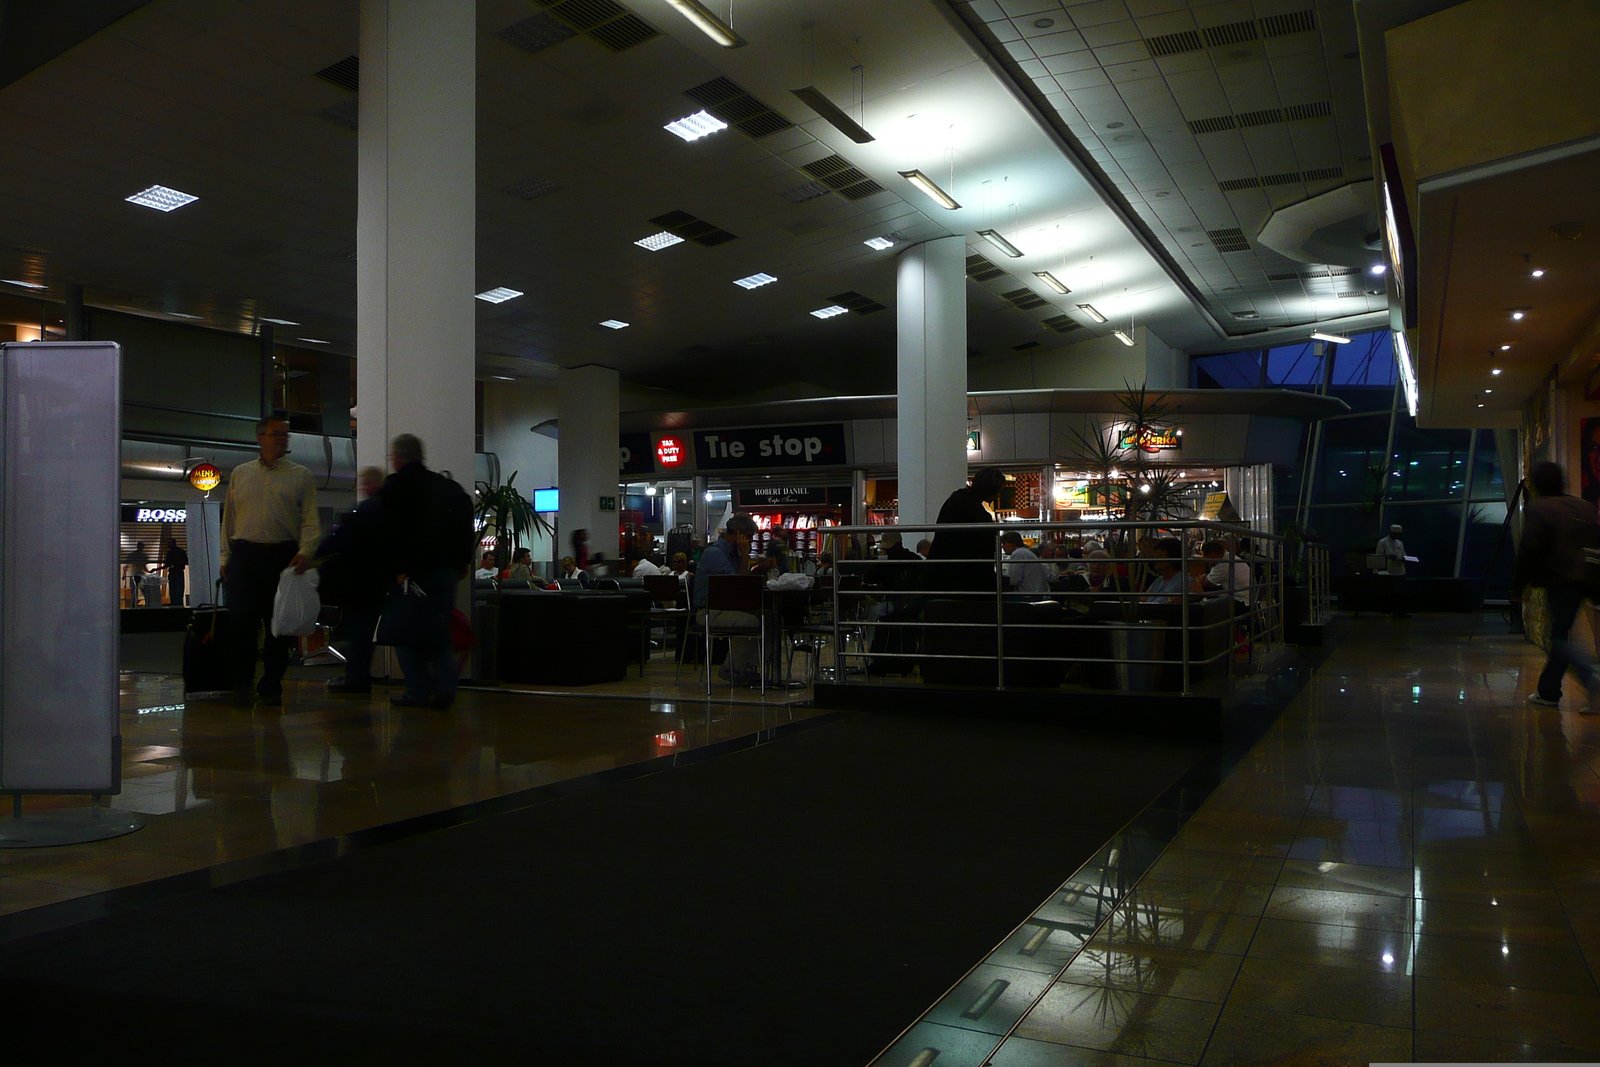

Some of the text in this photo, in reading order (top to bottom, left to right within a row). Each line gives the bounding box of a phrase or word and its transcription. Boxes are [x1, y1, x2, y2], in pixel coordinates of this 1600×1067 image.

[704, 435, 745, 458] Tie
[754, 487, 809, 496] ROBERT DANIEL
[137, 508, 187, 519] BOSS
